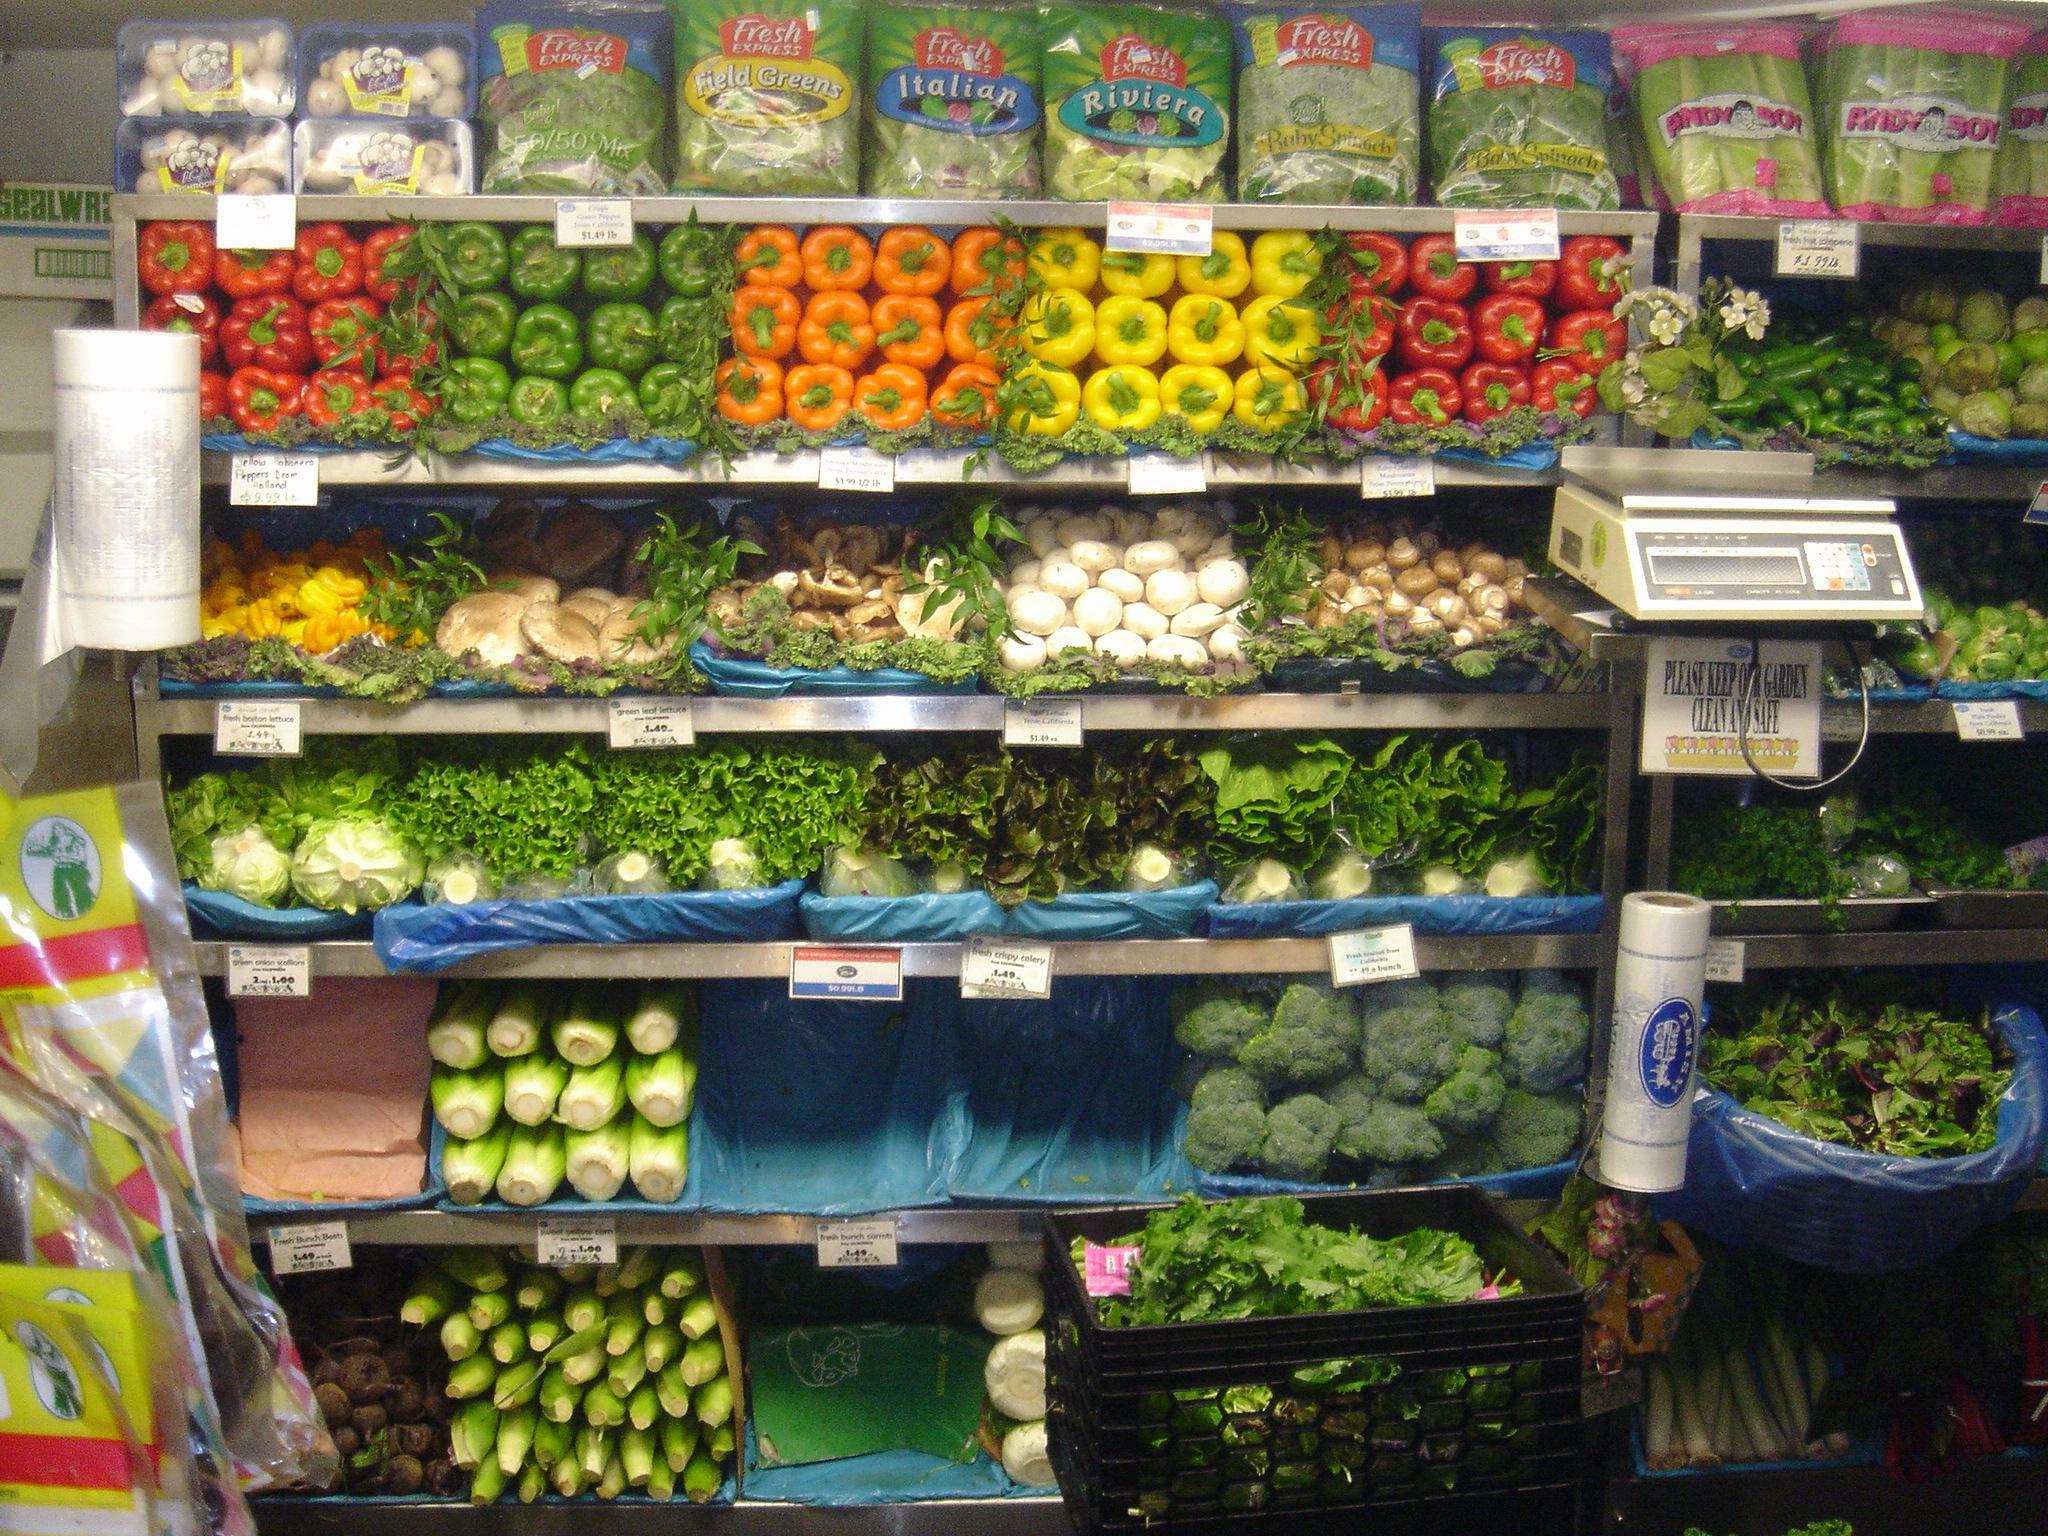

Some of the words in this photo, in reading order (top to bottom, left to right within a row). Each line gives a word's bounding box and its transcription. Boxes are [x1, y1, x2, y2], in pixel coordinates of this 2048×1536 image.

[733, 19, 801, 43] Fresh
[1292, 20, 1360, 49] Fresh
[541, 33, 614, 55] Fresh
[732, 43, 802, 57] EXPRESS
[928, 32, 992, 62] Fresh
[1113, 38, 1175, 69] Frsh
[539, 52, 613, 68] EXPRESS
[926, 54, 993, 74] EXPRSS
[1296, 47, 1361, 64] XPRESS
[1494, 45, 1562, 73] Fresh
[694, 64, 752, 98] Field
[757, 65, 844, 99] Greens
[1112, 62, 1178, 81] EXPRESS
[1493, 70, 1565, 85] EXPSS
[900, 74, 1018, 109] Italian
[1082, 85, 1205, 126] Riviera
[1665, 106, 1733, 139] ANDY
[1847, 106, 1929, 133] ANDY
[2011, 107, 2048, 129] DY
[514, 130, 588, 152] 50/50
[1521, 142, 1600, 171] Spinach
[582, 231, 605, 240] $1.49
[607, 230, 617, 240] lb
[235, 469, 270, 483] Peppers
[1664, 660, 1705, 695] PLEASE
[1707, 661, 1737, 697] KEEP
[1763, 663, 1808, 699] GARDEN
[269, 714, 295, 723] lettuce
[659, 706, 688, 715] lettuce
[1691, 697, 1728, 733] CLEAN
[1752, 699, 1780, 734] SAFE
[233, 959, 254, 968] green
[255, 959, 275, 967] onion
[994, 951, 1019, 962] crispy
[1020, 955, 1046, 966] celery
[1377, 963, 1402, 972] bunch
[253, 976, 260, 984] 2
[840, 1232, 865, 1241] bunch
[867, 1233, 893, 1241] carrots
